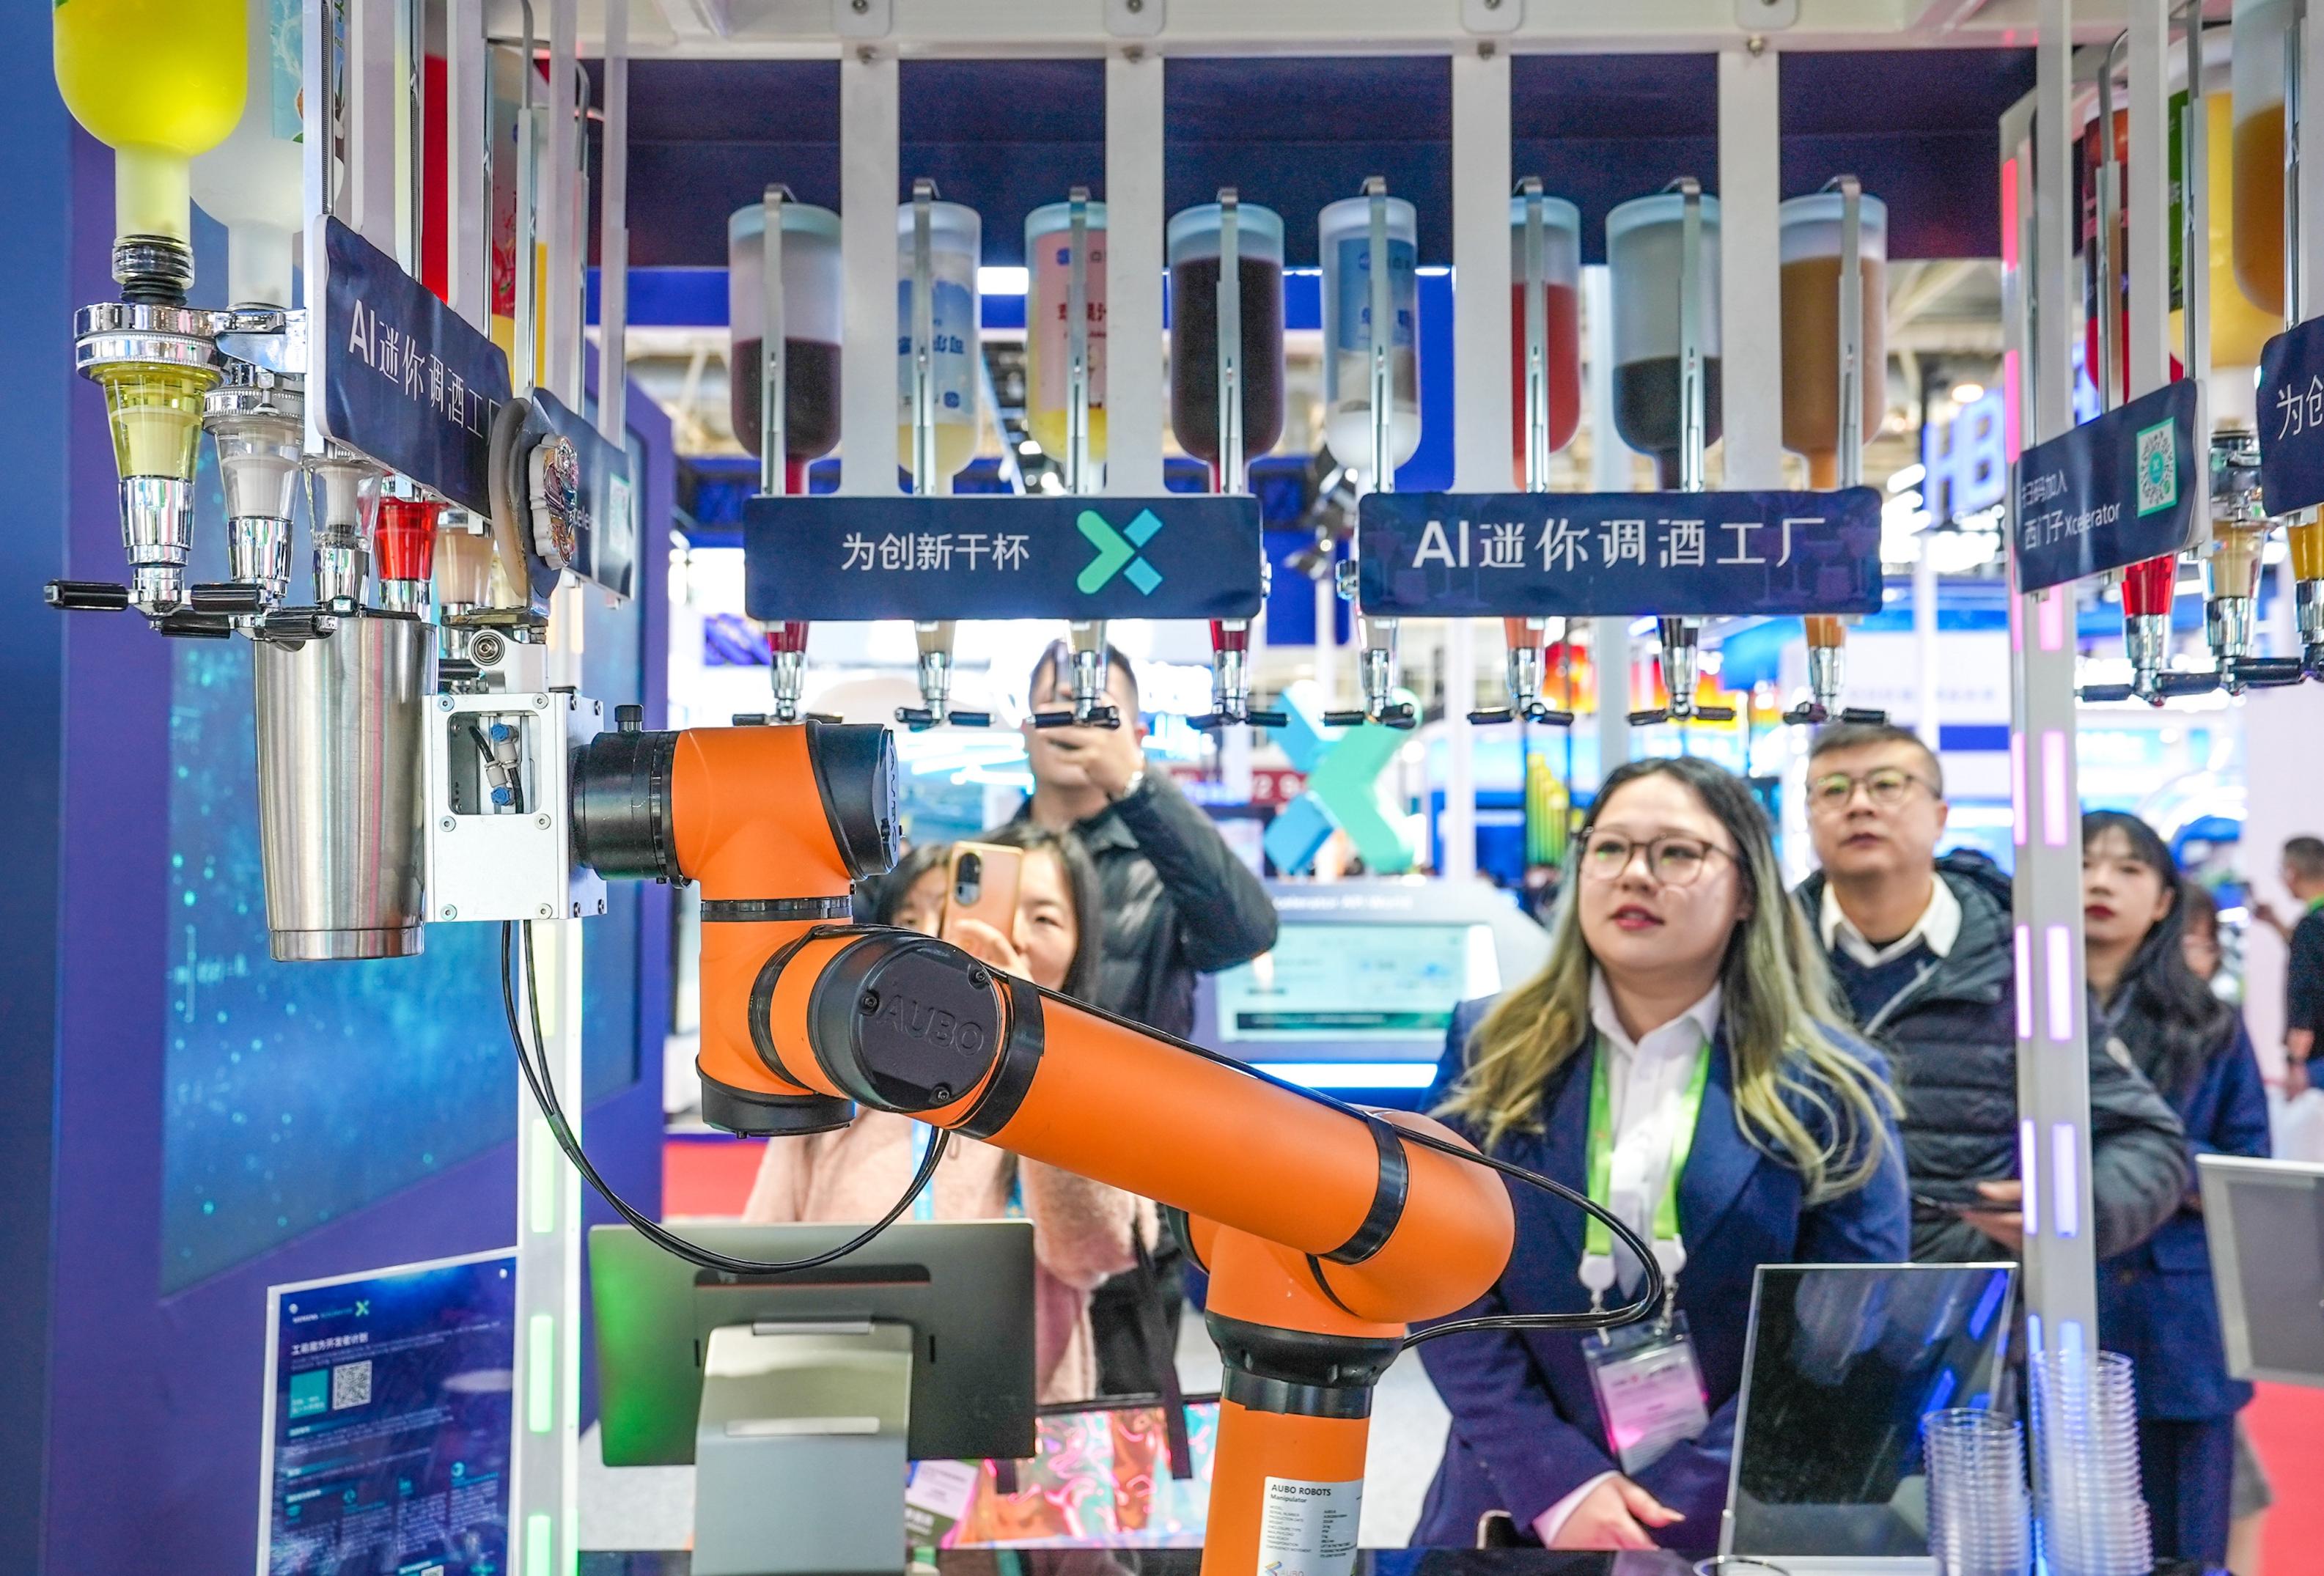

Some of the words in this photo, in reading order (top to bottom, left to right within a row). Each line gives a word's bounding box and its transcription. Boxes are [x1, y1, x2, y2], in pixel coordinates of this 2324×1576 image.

[1412, 518, 1826, 572] AI迷你调酒工厂
[2024, 509, 2064, 551] 西门子
[2064, 502, 2121, 537] Xcelerator
[842, 532, 1029, 571] 为创新干杯
[876, 994, 985, 1056] AUBO
[1270, 1493, 1307, 1503] Manipulator
[1271, 1484, 1296, 1494] AUBO
[1298, 1487, 1331, 1496] ROBOTS
